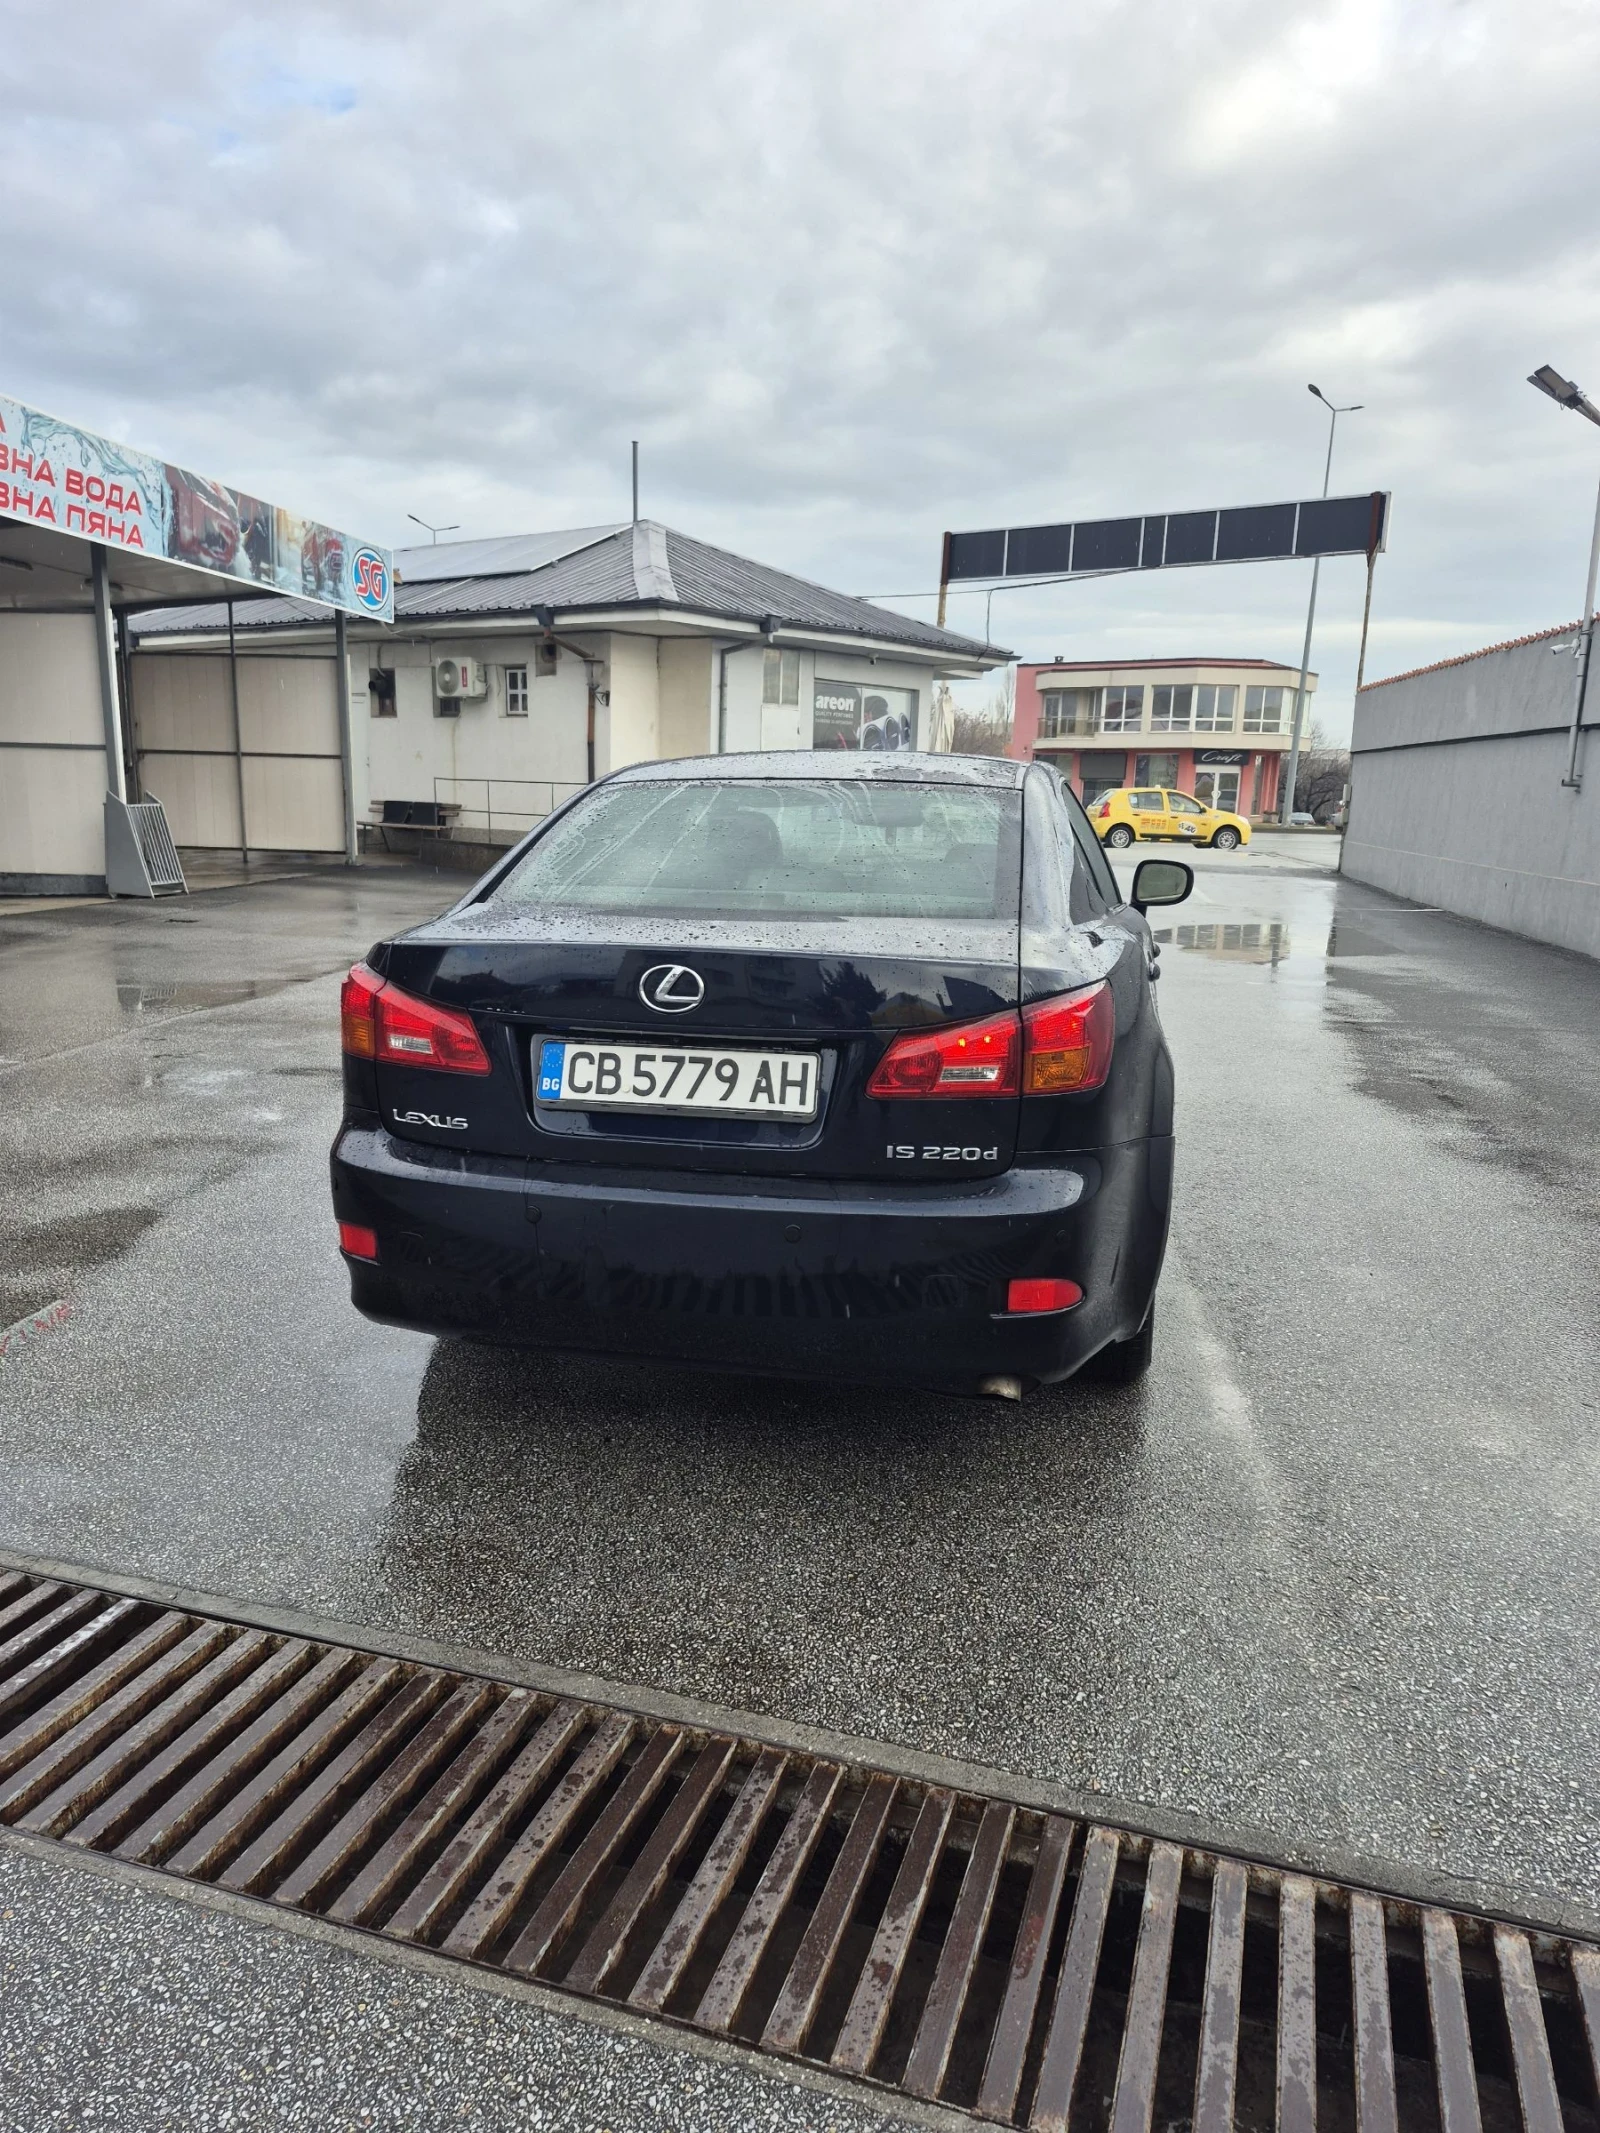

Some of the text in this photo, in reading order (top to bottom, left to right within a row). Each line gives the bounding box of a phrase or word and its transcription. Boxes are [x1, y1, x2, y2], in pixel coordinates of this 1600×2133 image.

[66, 468, 142, 516] ВОДА
[66, 504, 144, 549] ПЯНА
[356, 556, 384, 602] SG
[815, 695, 854, 712] areon
[1201, 750, 1243, 764] Craft
[542, 1077, 560, 1091] BG
[568, 1051, 809, 1106] CB 5779 AH
[392, 1108, 469, 1130] LEXUS
[886, 1145, 998, 1161] IS 220d
